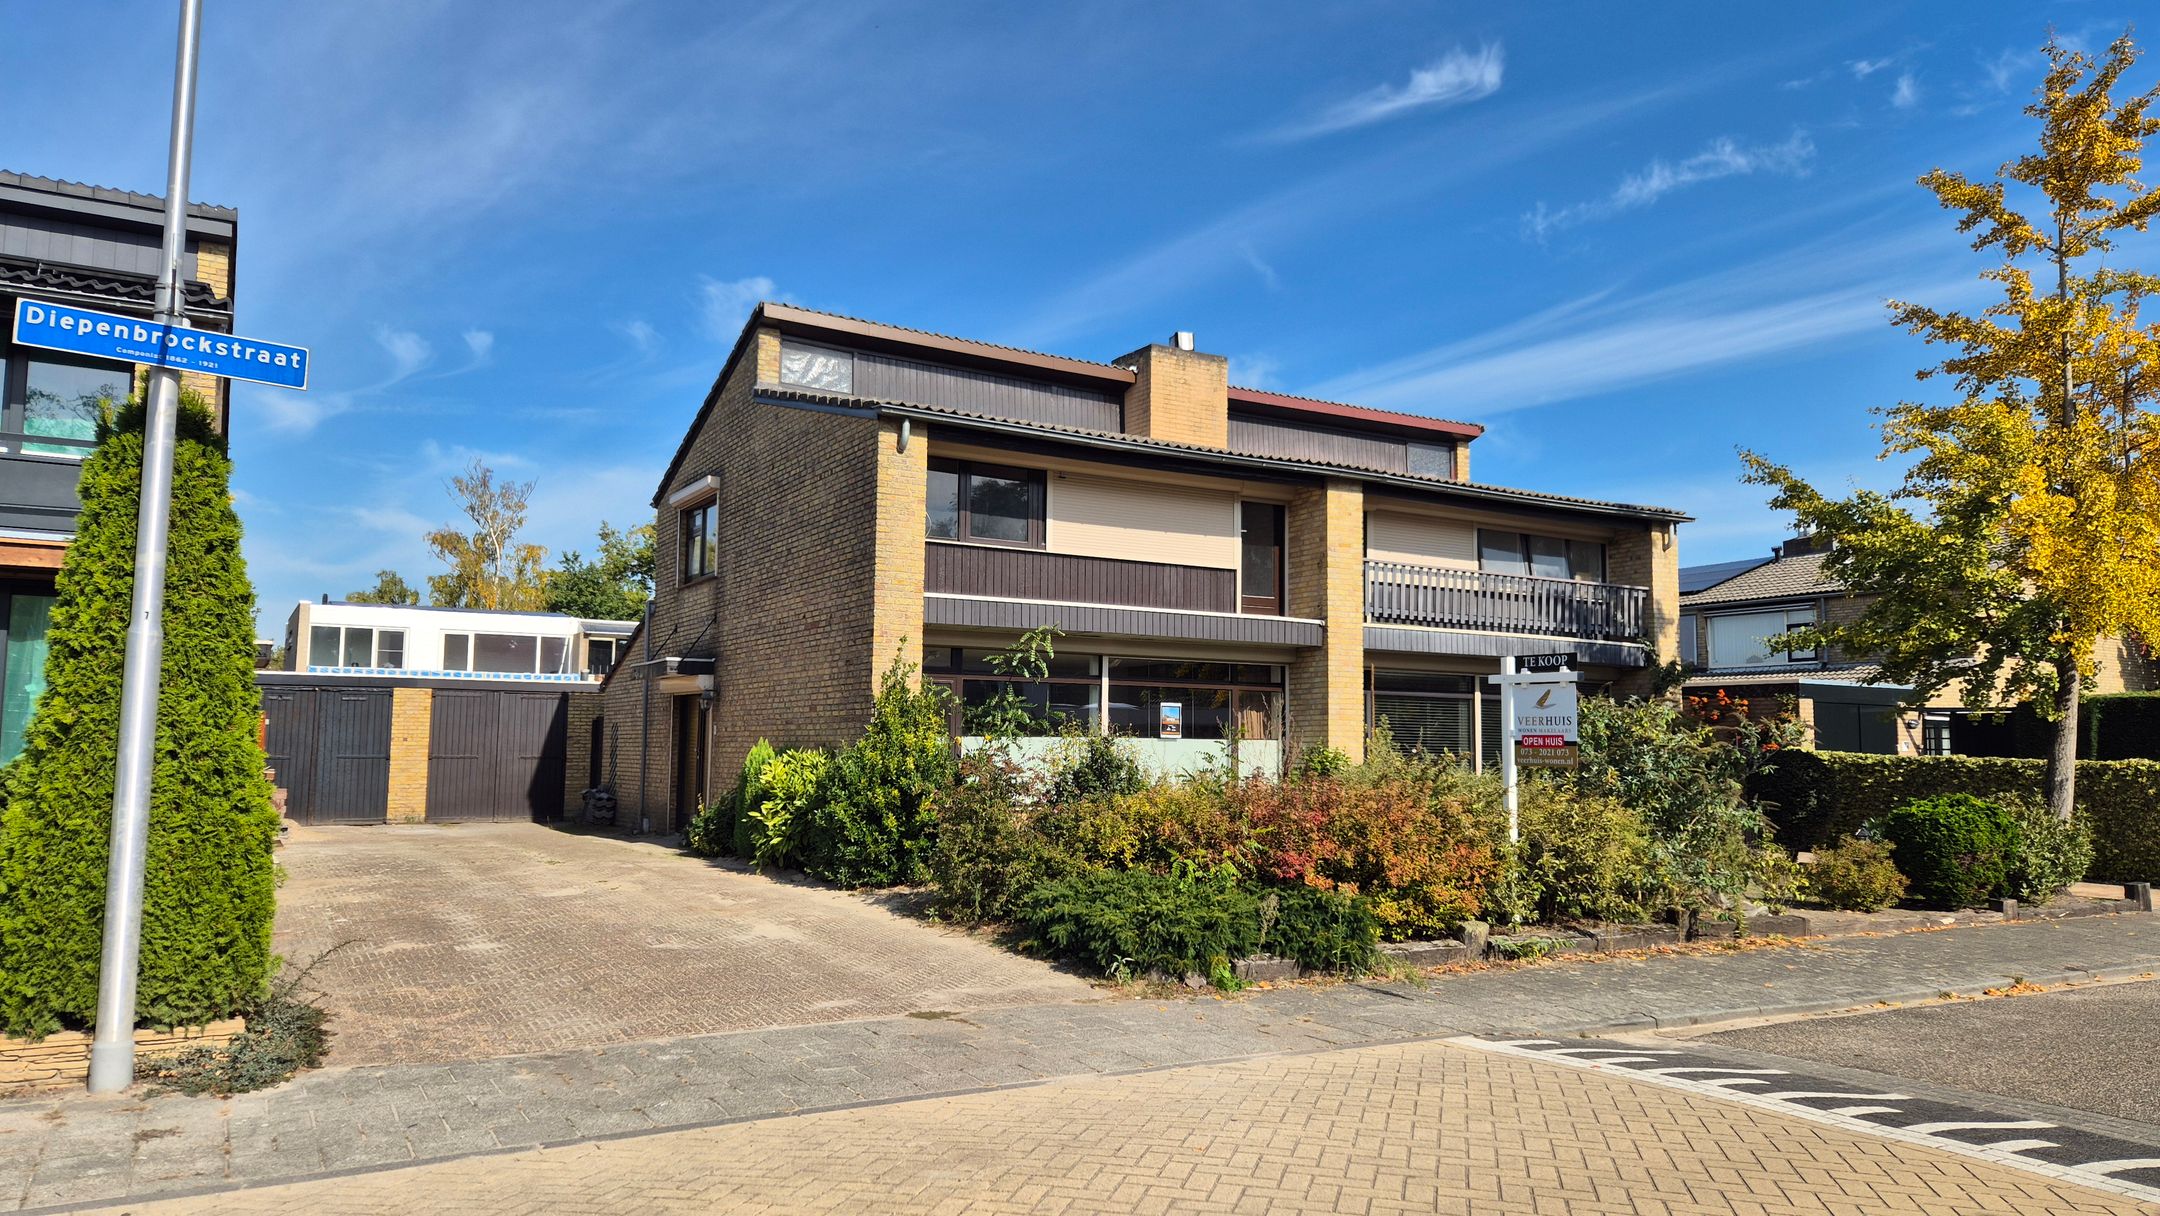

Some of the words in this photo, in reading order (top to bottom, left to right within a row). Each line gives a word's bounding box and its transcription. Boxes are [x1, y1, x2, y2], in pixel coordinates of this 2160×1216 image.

[25, 305, 301, 369] Diepenbrockstraat
[165, 354, 188, 364] 1862
[198, 360, 219, 369] 1921
[1522, 656, 1536, 668] TE
[1538, 654, 1568, 667] KOOP
[1517, 715, 1572, 727] VEERHUIS
[1523, 736, 1543, 746] OPEN
[1545, 736, 1563, 746] HUIS
[1520, 748, 1533, 756] 073
[1538, 748, 1554, 756] 2021
[1556, 748, 1570, 757] 073
